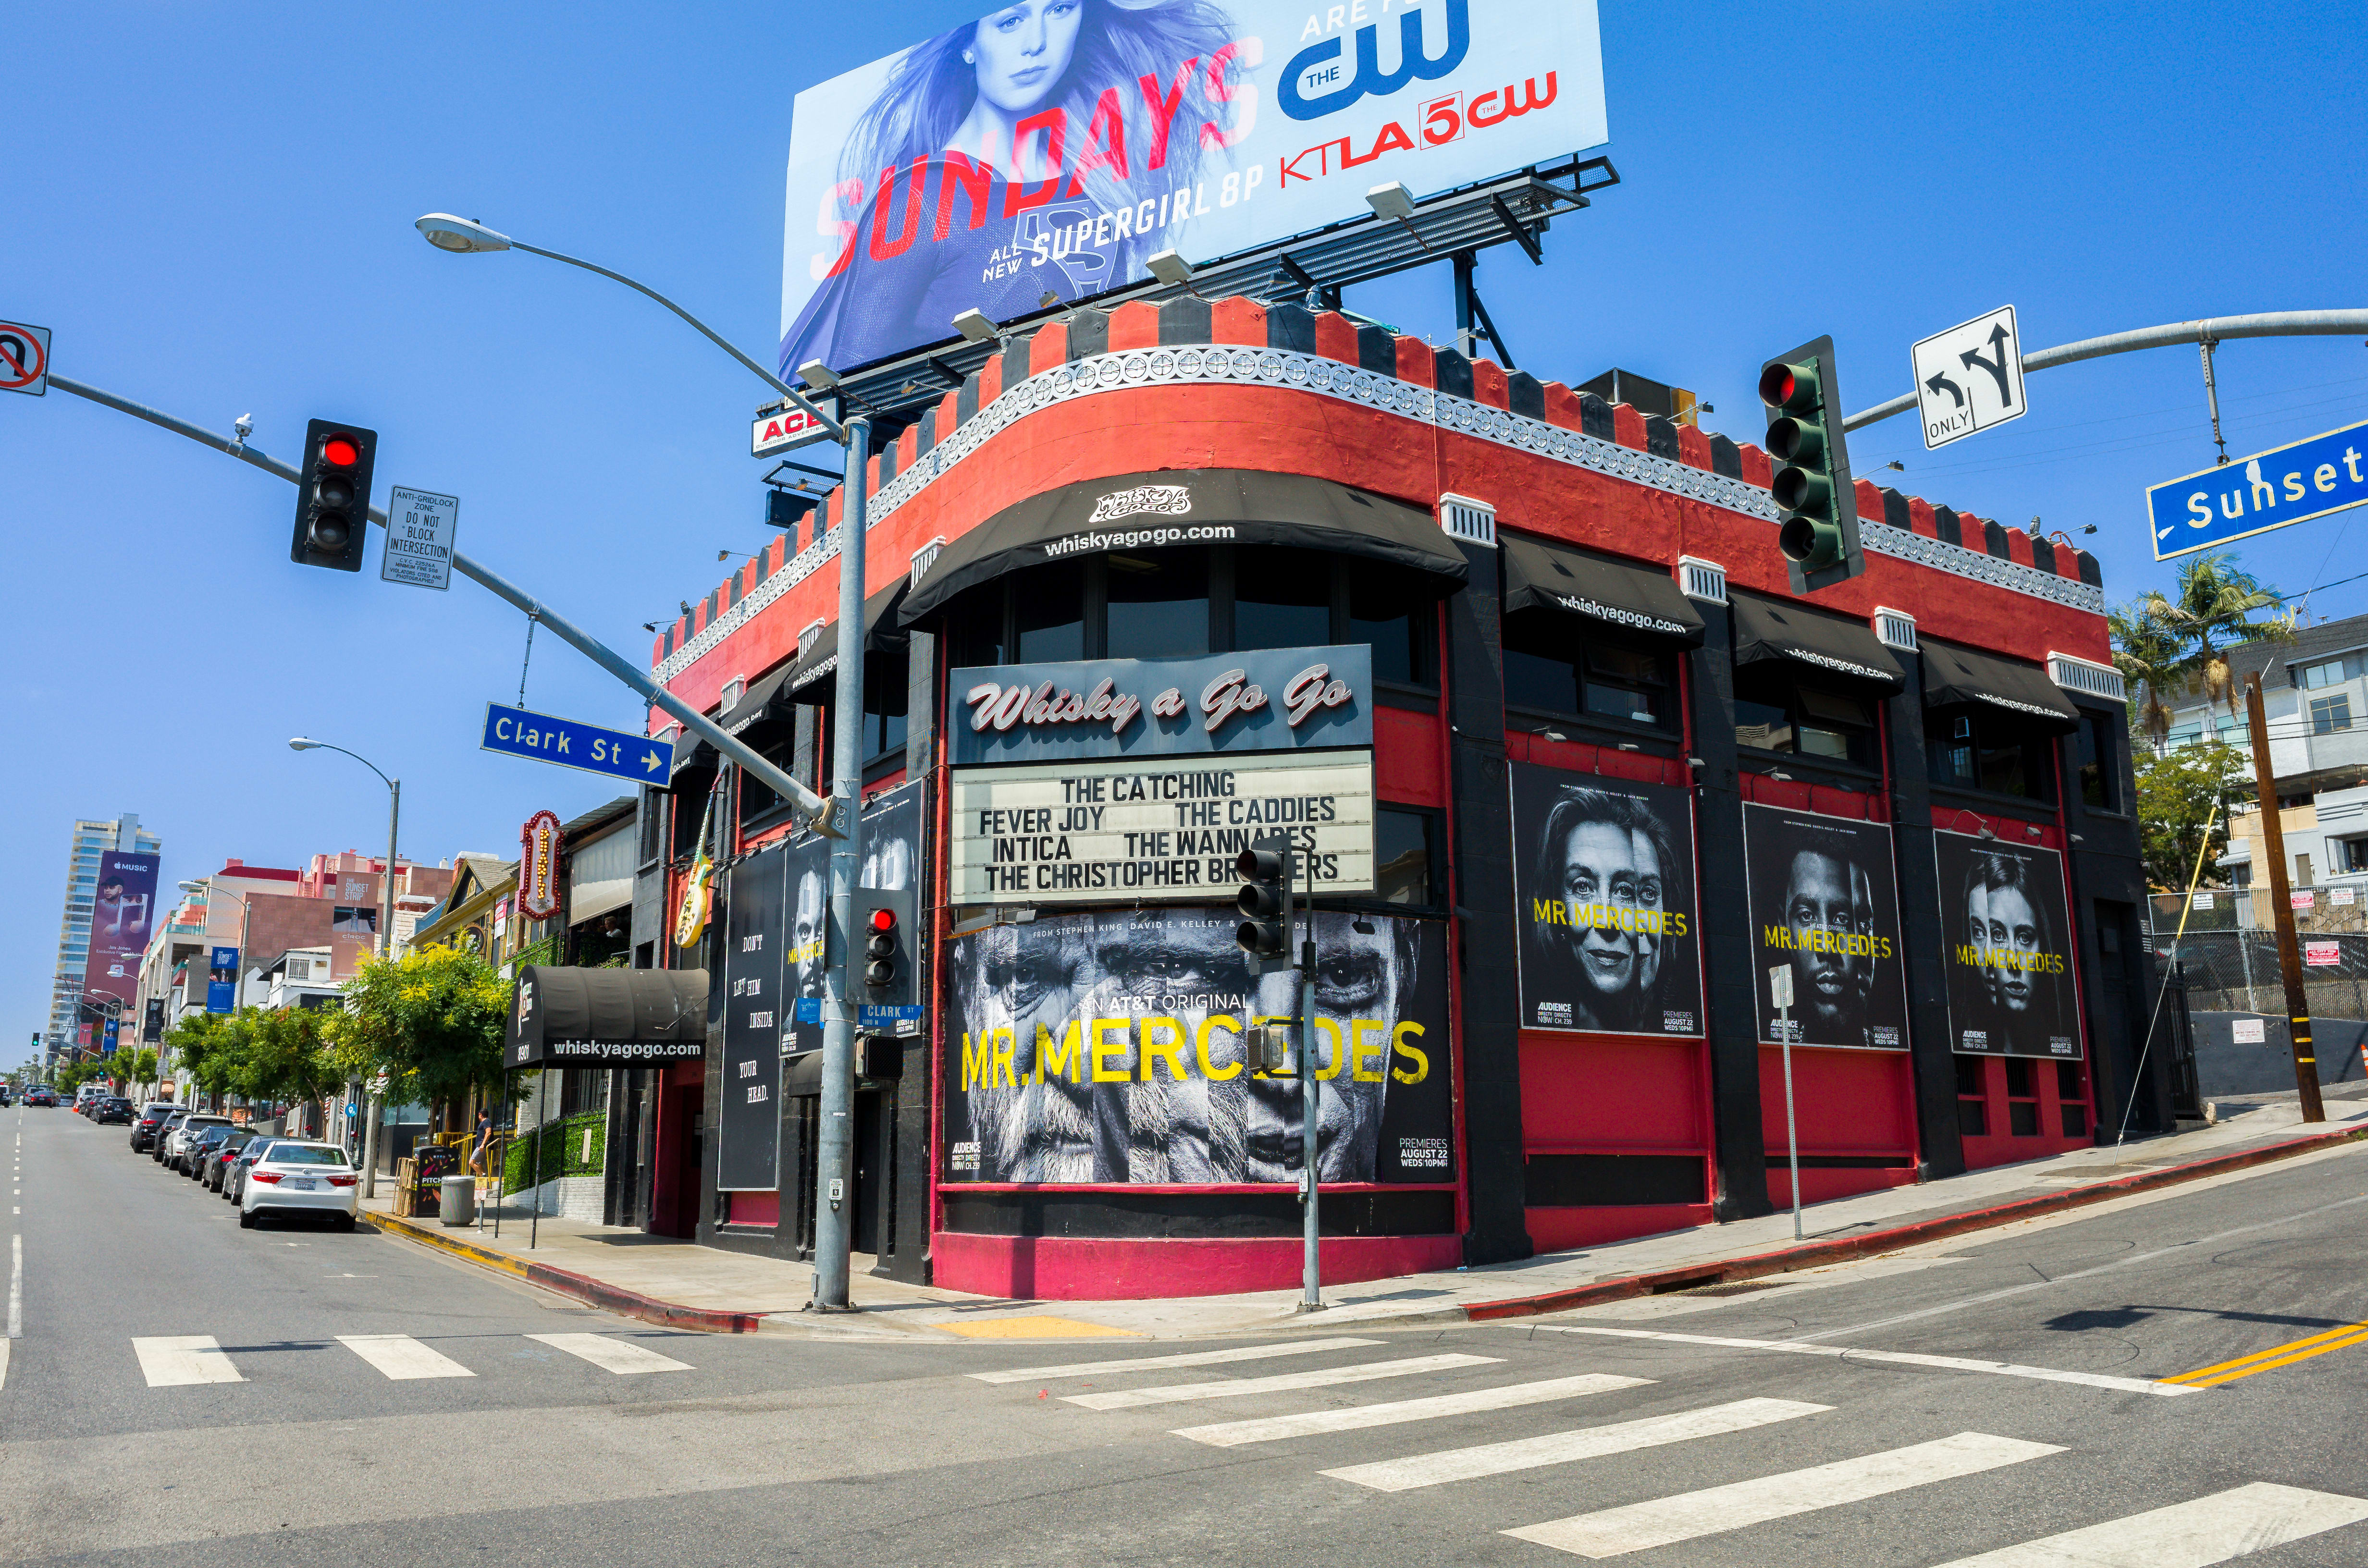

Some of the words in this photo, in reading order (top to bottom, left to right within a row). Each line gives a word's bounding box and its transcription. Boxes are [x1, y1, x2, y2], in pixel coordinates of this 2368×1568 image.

[1299, 0, 1369, 42] ARE
[1306, 66, 1340, 88] THE
[1467, 70, 1558, 128] CW
[1481, 104, 1498, 114] THE
[1280, 121, 1416, 189] KTLA
[1423, 97, 1461, 145] 5
[809, 36, 1264, 282] SUNDAYS
[1031, 183, 1211, 268] SUPERGIRL
[1219, 164, 1264, 209] 8P
[989, 243, 1022, 265] ALL
[982, 257, 1023, 283] NEW
[1930, 410, 1969, 438] ONLY
[755, 437, 786, 449] OUTDOOR
[788, 425, 827, 440] ADVERTISIN
[2187, 446, 2364, 529] Sunset
[396, 491, 455, 508] ANTI-GRIDLOCK
[414, 502, 435, 513] ZONE
[406, 511, 418, 524] DO
[423, 514, 441, 528] NOT
[407, 526, 435, 542] BLOCK
[1045, 523, 1235, 558] whiskyagogo.com
[390, 538, 449, 559] INTERSECTION
[390, 567, 416, 576] VIOLATORS
[395, 562, 416, 570] MINIMUM
[396, 574, 435, 584] PHOTOGRAPHED
[1557, 596, 1686, 634] whiskyagogo.com
[792, 654, 838, 689] whiskyagogo
[965, 677, 1140, 735] Whisky
[1151, 687, 1185, 717] a
[1200, 668, 1269, 733] Go
[1283, 663, 1352, 727] Go
[496, 717, 571, 754] Clark
[591, 738, 621, 765] St
[1061, 778, 1105, 803] THE
[1113, 772, 1235, 802] CATCHING
[980, 808, 1051, 835] FEVER
[1058, 806, 1105, 832] JOY
[1174, 801, 1221, 827] THE
[1229, 796, 1336, 825] CADDIES
[992, 835, 1072, 863] INTICA
[1124, 832, 1170, 858] THE
[122, 864, 148, 872] MUSIC
[985, 865, 1029, 892] THE
[1036, 858, 1200, 889] CHRISTOPHER
[1208, 853, 1338, 884] BRERS
[1611, 898, 1635, 907] ORIGINAL
[1033, 930, 1053, 939] FROM
[1056, 925, 1095, 936] STEPHEN
[1098, 923, 1122, 932] KING
[1130, 921, 1163, 930] DAVID
[1167, 920, 1176, 929] E.
[1181, 920, 1221, 929] KELLEY
[742, 934, 763, 953] DON'T
[788, 940, 824, 965] MR.MERCE
[734, 977, 746, 997] LET
[747, 979, 761, 996] HIM
[867, 1005, 901, 1017] CLARK
[1080, 997, 1104, 1012] AN
[1109, 995, 1157, 1011] AT&T
[1162, 993, 1252, 1010] ORIGINAL
[1538, 1002, 1572, 1013] AUDIENCE
[750, 1011, 773, 1029] INSIDE
[1538, 1016, 1553, 1024] NOW
[1664, 1010, 1693, 1019] PREMIERES
[1770, 1019, 1798, 1029] AUDNCE
[1963, 1030, 1987, 1039] AUDIENCE
[518, 1044, 530, 1062] 8901
[554, 1040, 701, 1059] whiskyagogo.com
[740, 1060, 757, 1078] YOUR
[747, 1085, 768, 1103] HEAD.
[952, 1141, 981, 1153] AUDIENCE
[1400, 1138, 1448, 1149] PREMIERES
[1401, 1149, 1436, 1158] AUGUST
[1438, 1150, 1448, 1159] 22
[1401, 1158, 1423, 1167] WEDS
[952, 1160, 964, 1170] NOW
[972, 1161, 980, 1170] 239
